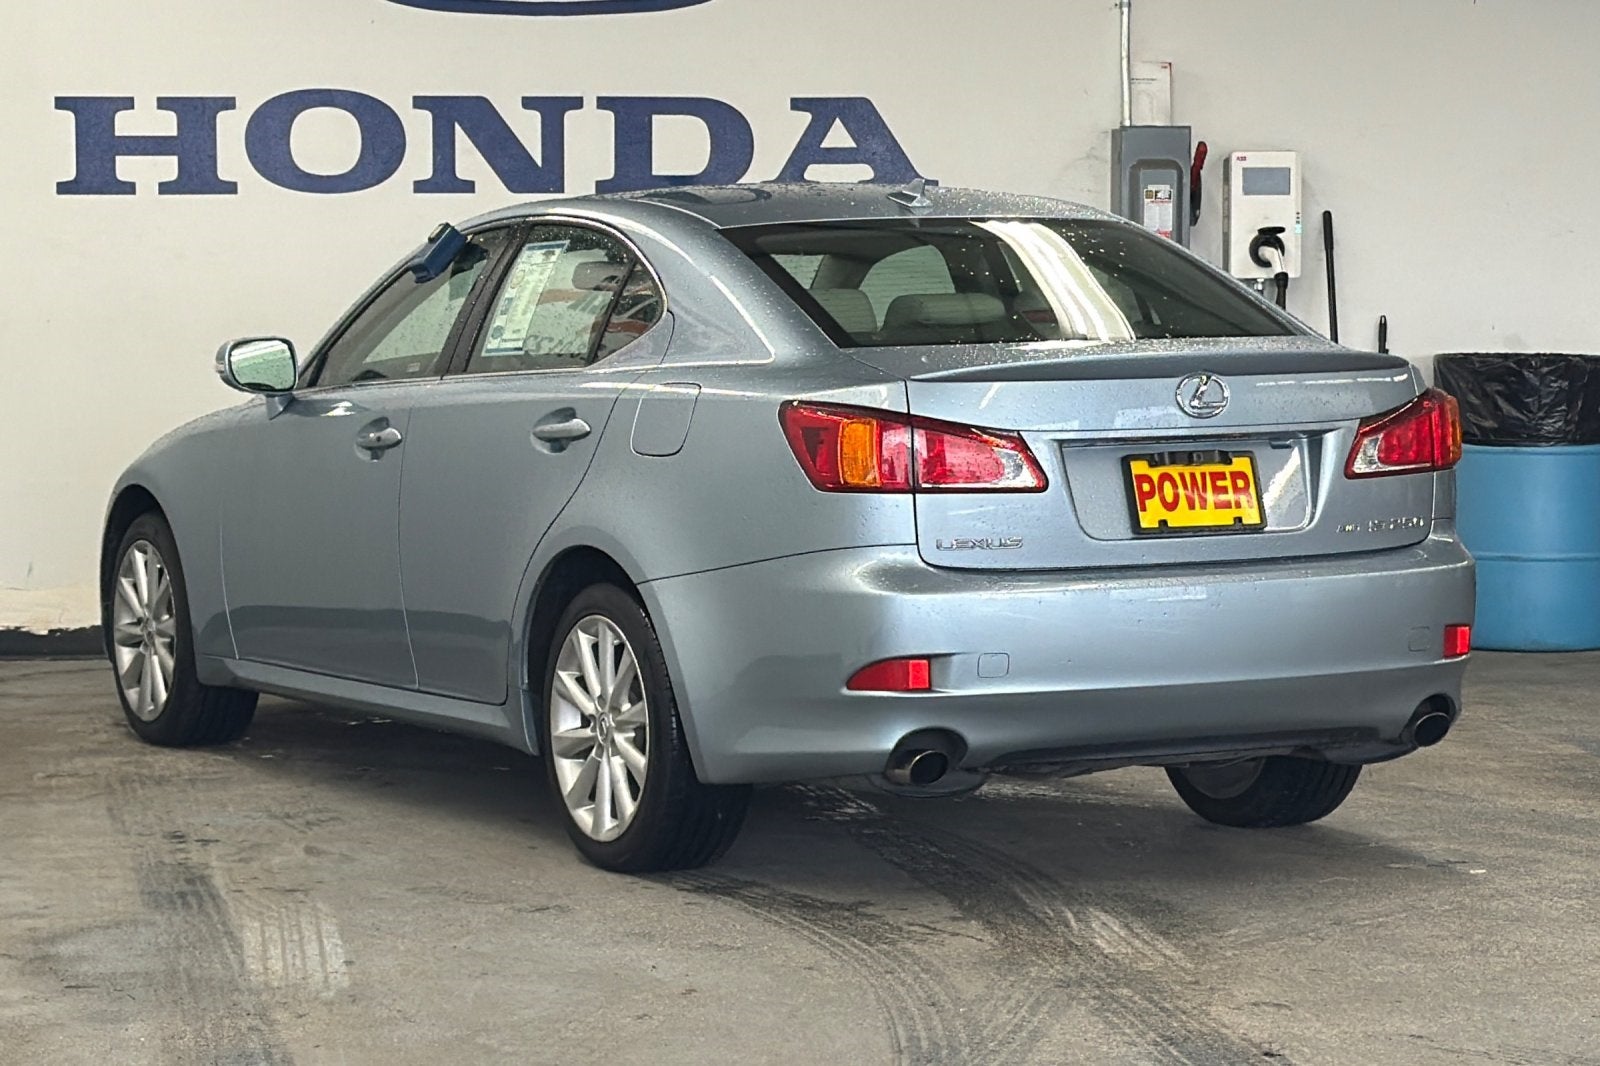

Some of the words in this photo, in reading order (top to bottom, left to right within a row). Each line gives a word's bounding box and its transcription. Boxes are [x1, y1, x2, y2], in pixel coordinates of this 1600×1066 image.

[54, 88, 939, 195] HONDA
[1134, 470, 1254, 512] POWER
[936, 536, 1023, 551] LEXUS
